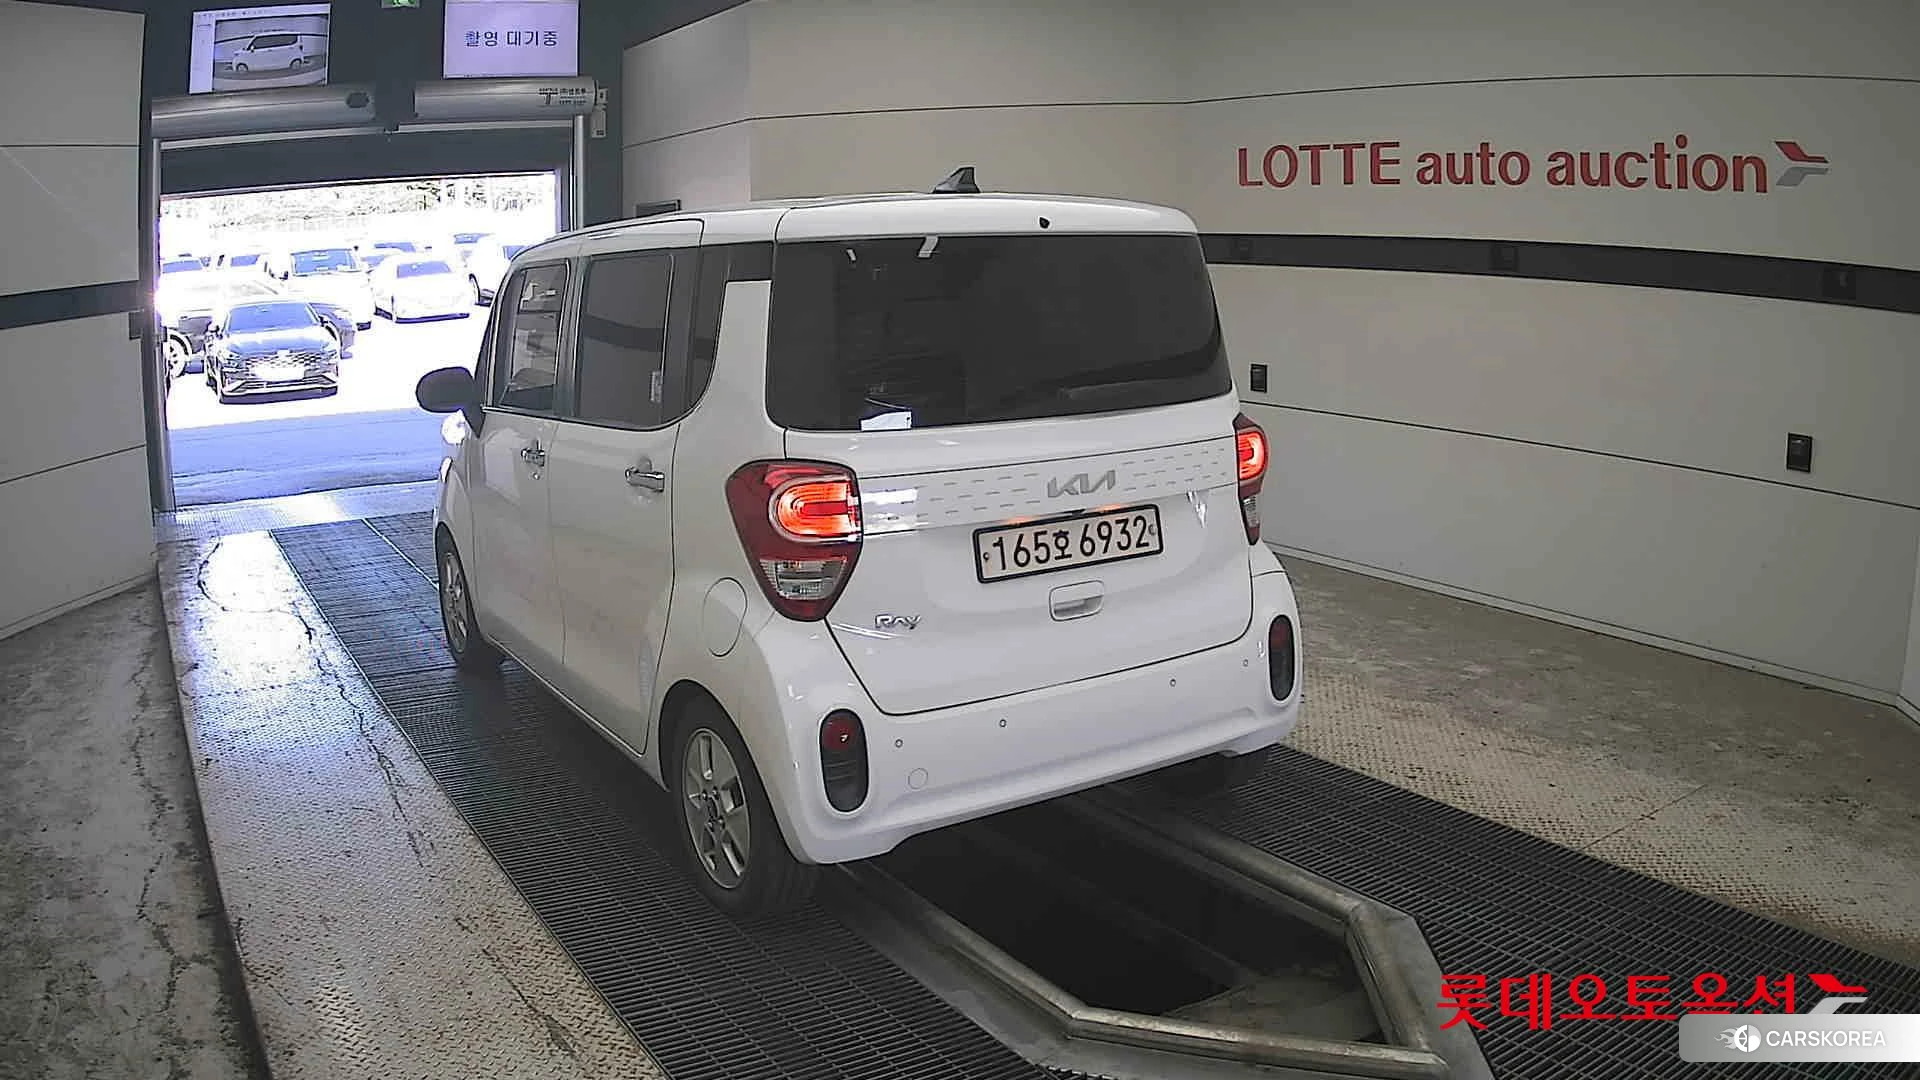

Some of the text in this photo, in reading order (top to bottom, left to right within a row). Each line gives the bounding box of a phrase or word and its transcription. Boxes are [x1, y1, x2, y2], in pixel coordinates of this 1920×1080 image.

[1237, 134, 1768, 194] LOTTE auto auction
[992, 514, 1150, 571] 165호 6932
